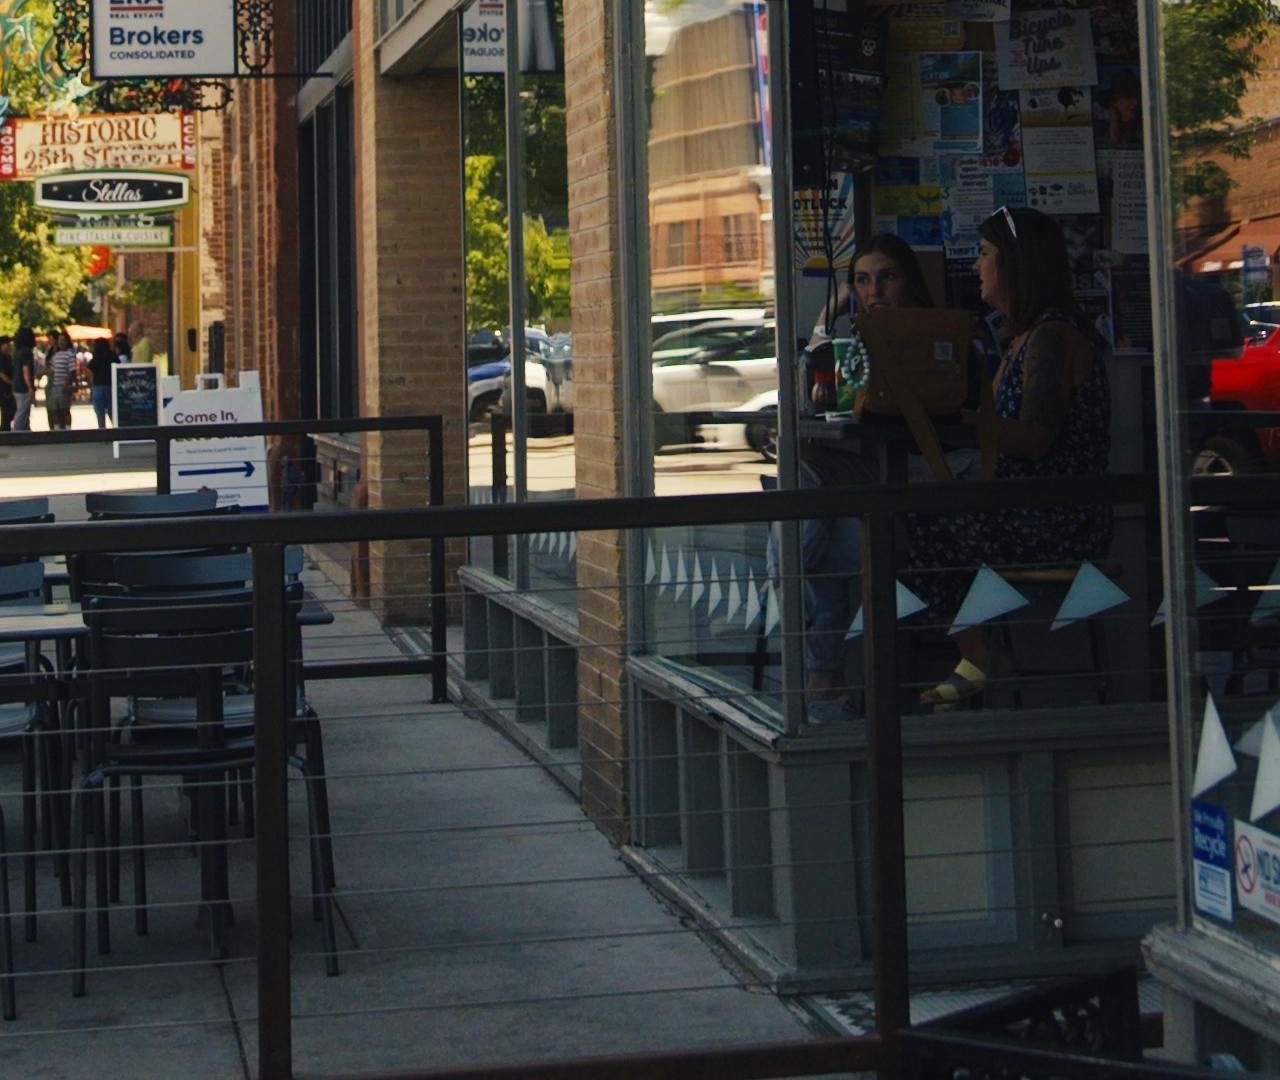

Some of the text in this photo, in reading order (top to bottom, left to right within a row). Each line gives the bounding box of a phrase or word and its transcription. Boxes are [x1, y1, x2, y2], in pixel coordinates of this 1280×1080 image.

[109, 25, 204, 46] Brokers
[1010, 10, 1075, 40] Bicycle
[109, 49, 196, 61] CONSOLIDATED
[40, 116, 158, 147] HISTORIC
[24, 142, 178, 172] 25th STREET
[82, 177, 144, 203] Stellas
[793, 198, 847, 210] OTLUCK
[86, 231, 122, 242] ITALIAN
[173, 409, 238, 424] Come In,
[1194, 826, 1227, 860] Recycle
